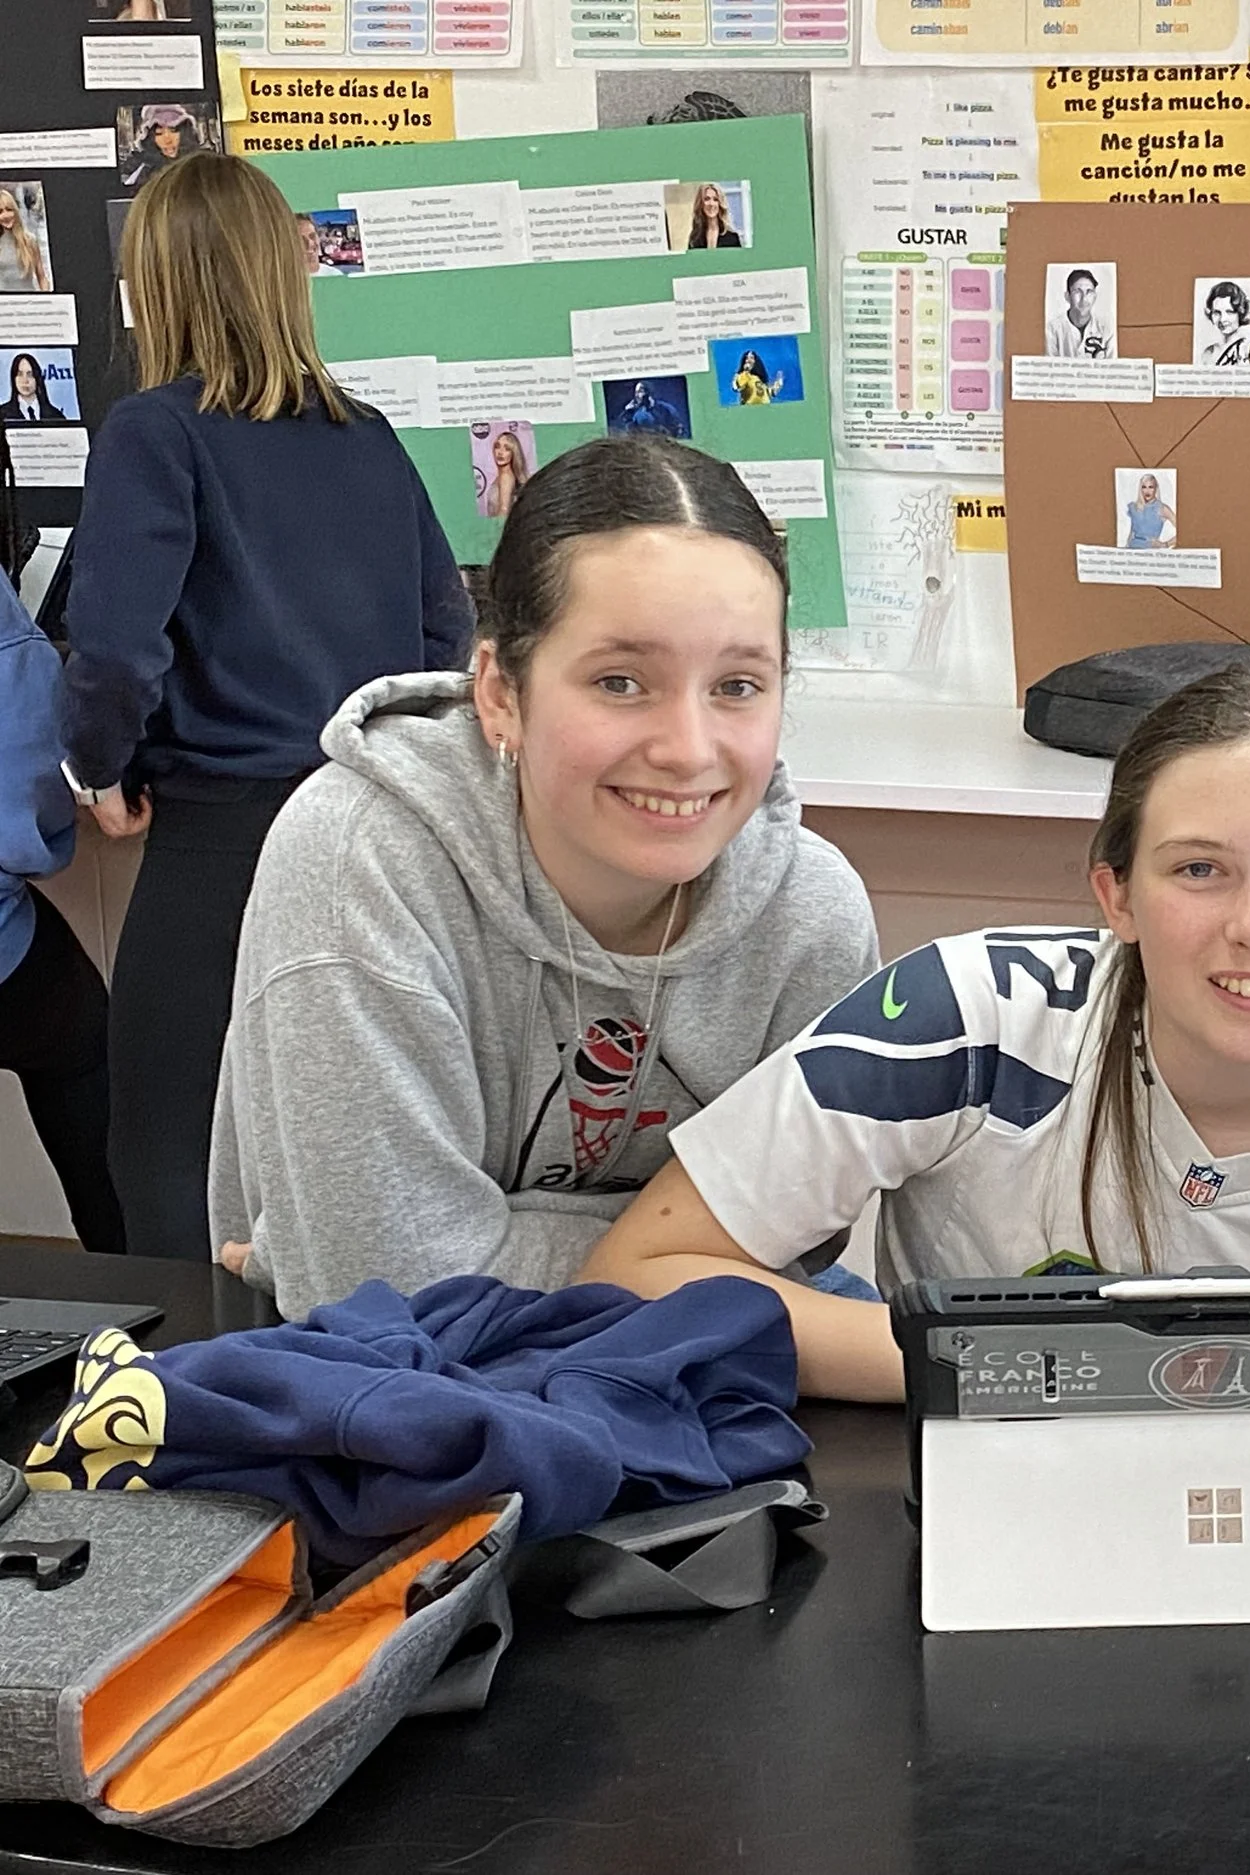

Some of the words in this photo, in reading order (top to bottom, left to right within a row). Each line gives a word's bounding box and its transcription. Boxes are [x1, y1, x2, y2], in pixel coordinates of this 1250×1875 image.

[1046, 66, 1082, 89] ¿Te
[1088, 67, 1150, 91] gusta
[1154, 64, 1239, 83] cantar?
[251, 79, 282, 97] Los
[287, 78, 335, 97] siete
[339, 77, 379, 98] días
[383, 80, 407, 99] de
[411, 79, 430, 99] la
[1064, 98, 1098, 112] me
[1102, 94, 1165, 120] gusta
[250, 110, 324, 125] semana
[404, 108, 433, 127] los
[243, 137, 305, 151] meses
[309, 133, 338, 151] del
[1101, 133, 1135, 151] Me
[1138, 133, 1202, 158] gusta
[1204, 130, 1225, 150] la
[1212, 163, 1247, 178] me
[897, 228, 968, 245] GUSTAR
[956, 500, 982, 518] Mi
[959, 1366, 1101, 1382] FRANCO
